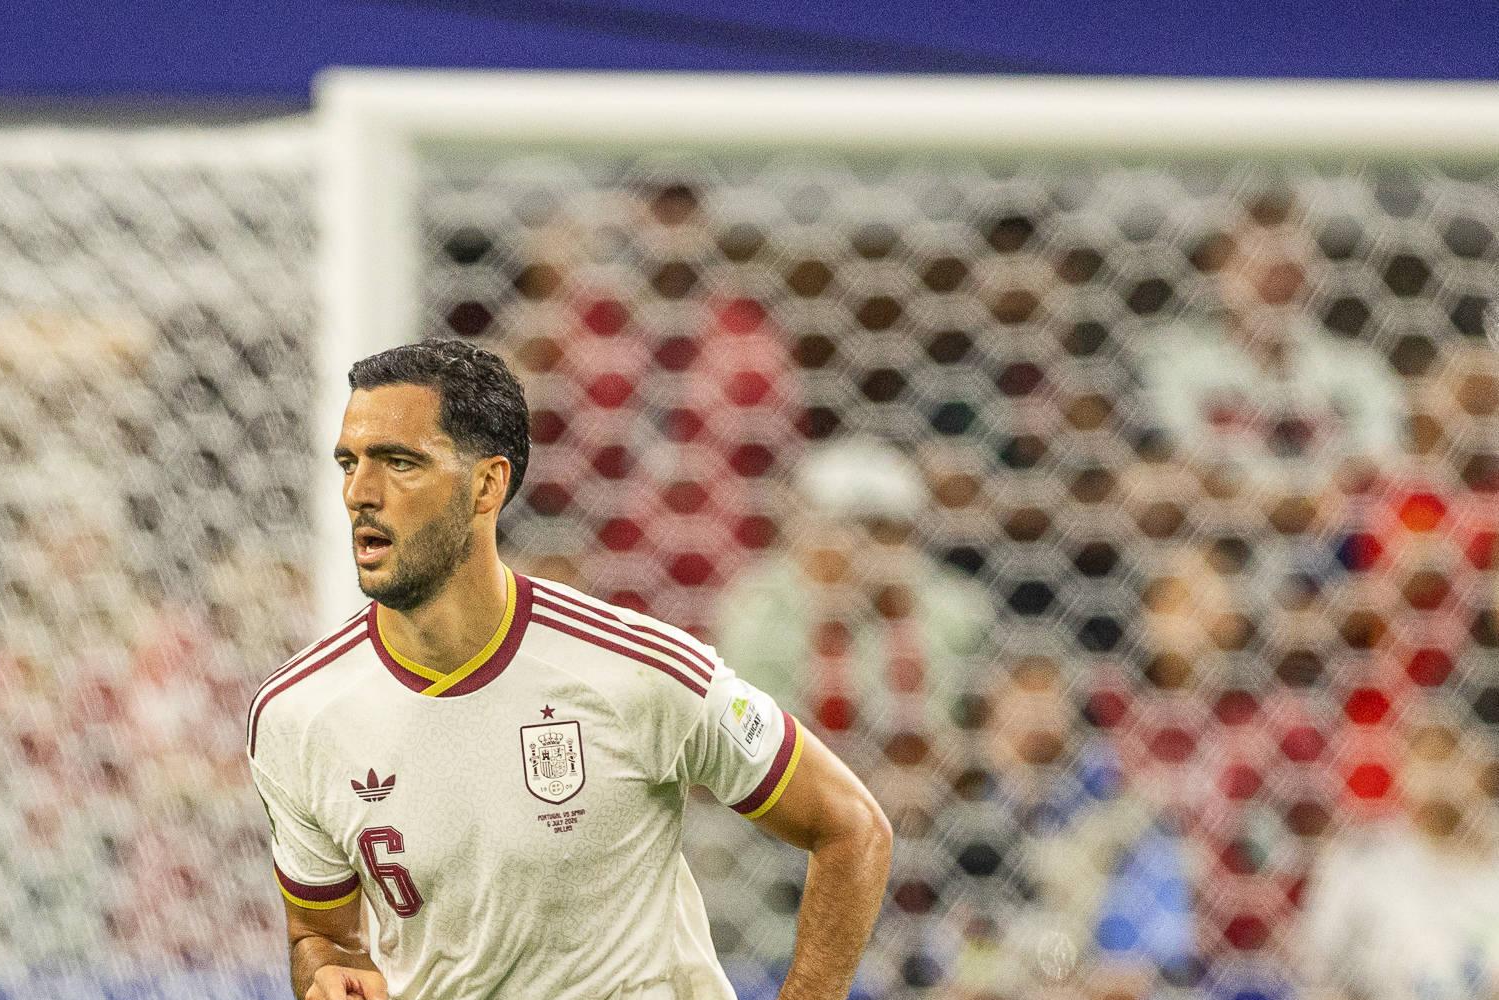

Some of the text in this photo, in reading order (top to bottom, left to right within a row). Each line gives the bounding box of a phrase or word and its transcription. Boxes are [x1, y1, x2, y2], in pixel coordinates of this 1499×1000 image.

[538, 812, 562, 821] PORTUGAL
[552, 819, 563, 827] JULY
[554, 825, 573, 833] DALLAS
[357, 825, 425, 918] 6
